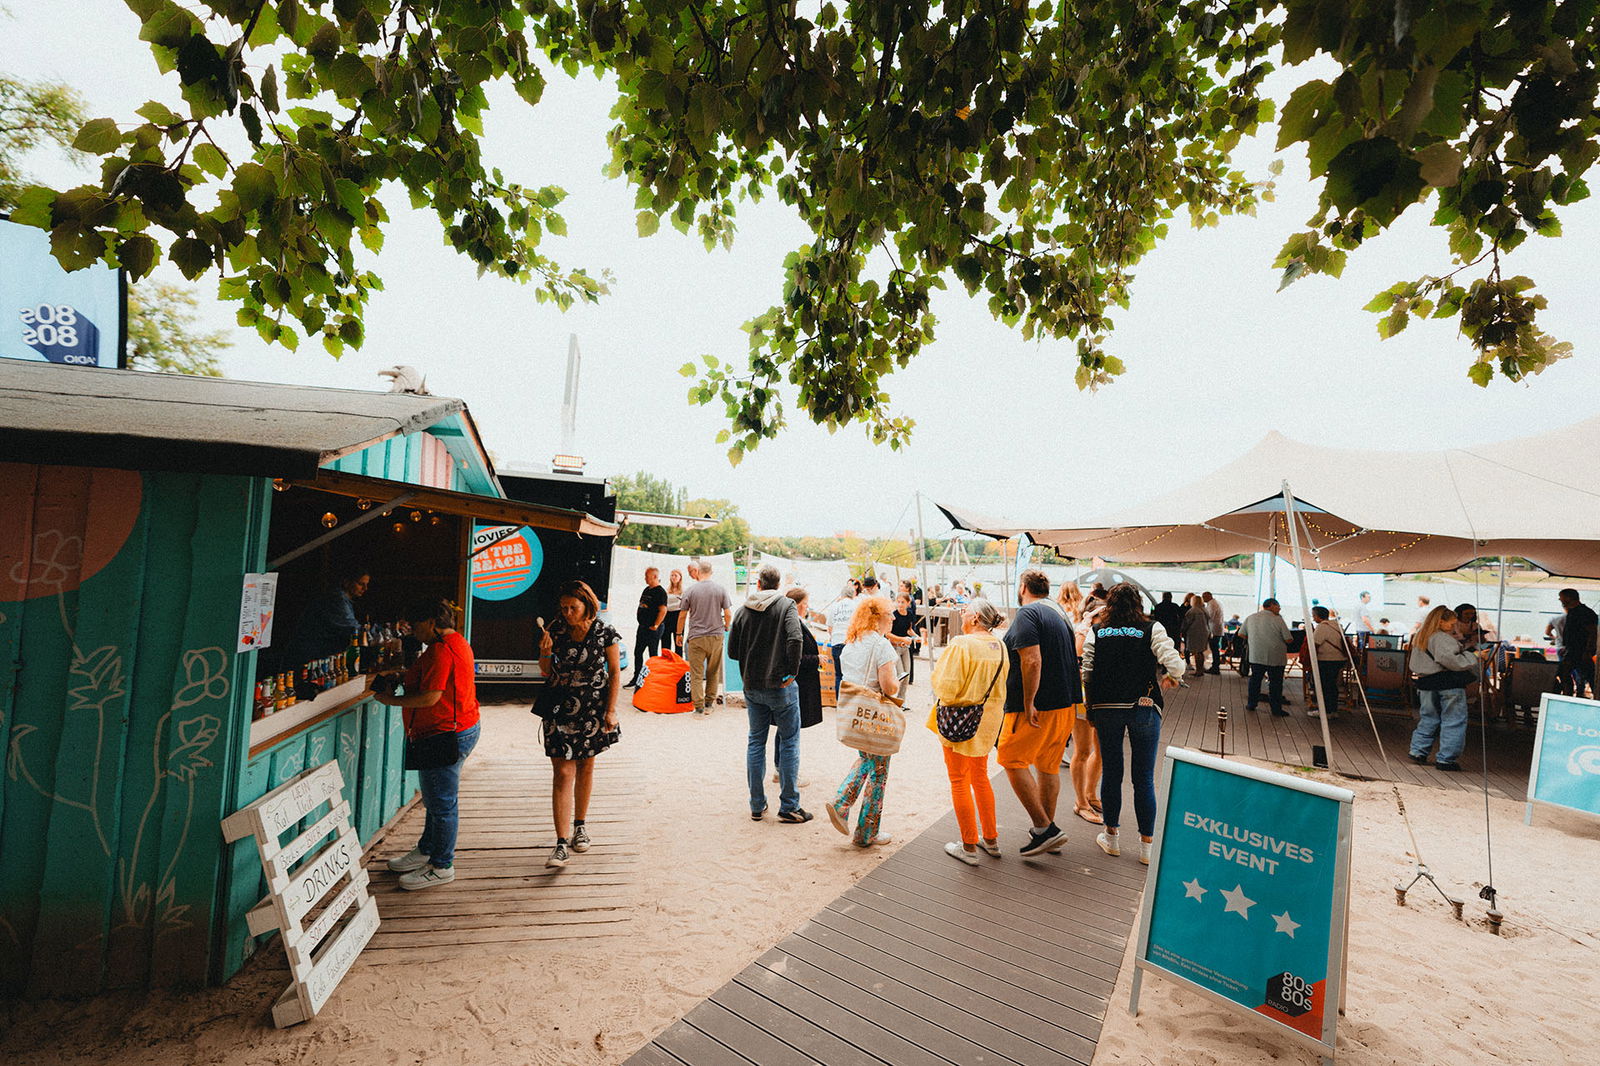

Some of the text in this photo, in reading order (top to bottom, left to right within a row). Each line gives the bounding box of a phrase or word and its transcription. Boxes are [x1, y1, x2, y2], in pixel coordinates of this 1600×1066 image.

[490, 543, 523, 557] THE
[1555, 722, 1574, 733] LP
[1183, 811, 1314, 864] EXKLUSIVES
[1208, 840, 1280, 876] EVENT
[303, 844, 350, 903] DRINKS
[1282, 972, 1314, 997] 80s
[1281, 986, 1312, 1011] 80s
